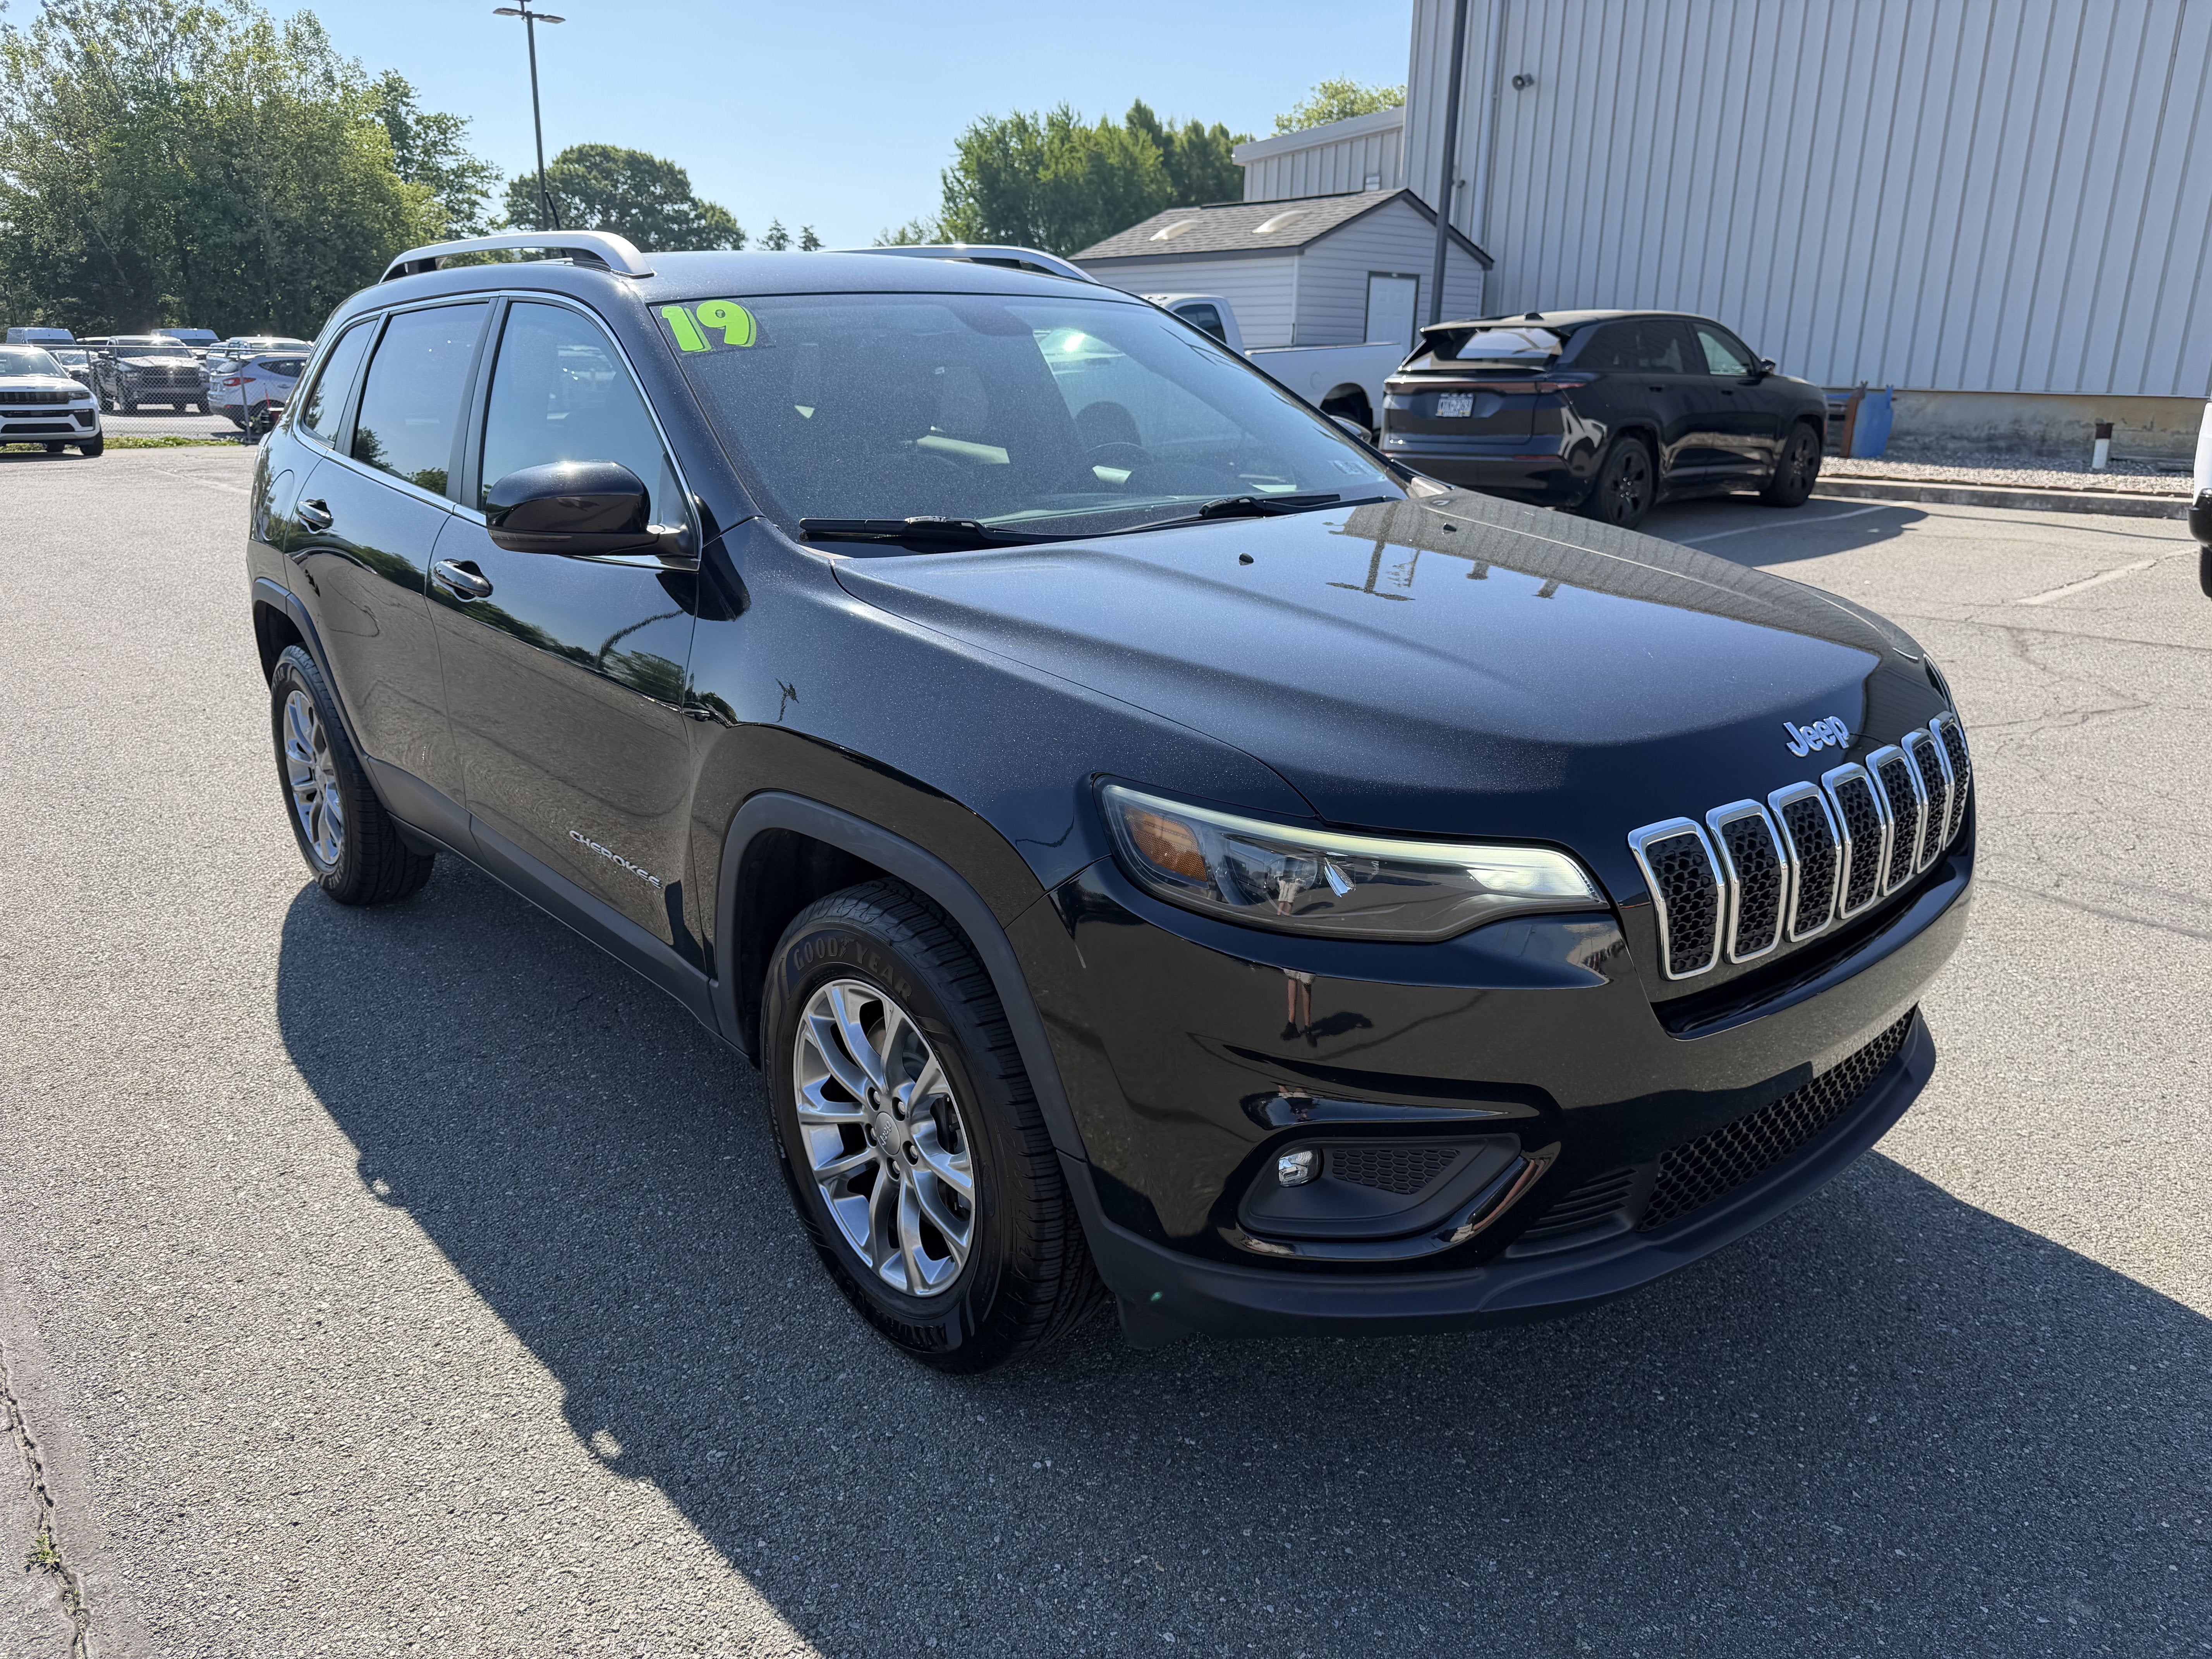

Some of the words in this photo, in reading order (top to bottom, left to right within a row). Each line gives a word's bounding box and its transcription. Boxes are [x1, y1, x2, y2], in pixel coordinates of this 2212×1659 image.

[661, 299, 757, 352] 19
[1783, 715, 1850, 758] Jeep
[569, 830, 663, 889] CHEROKEE
[879, 1120, 892, 1146] Jeep
